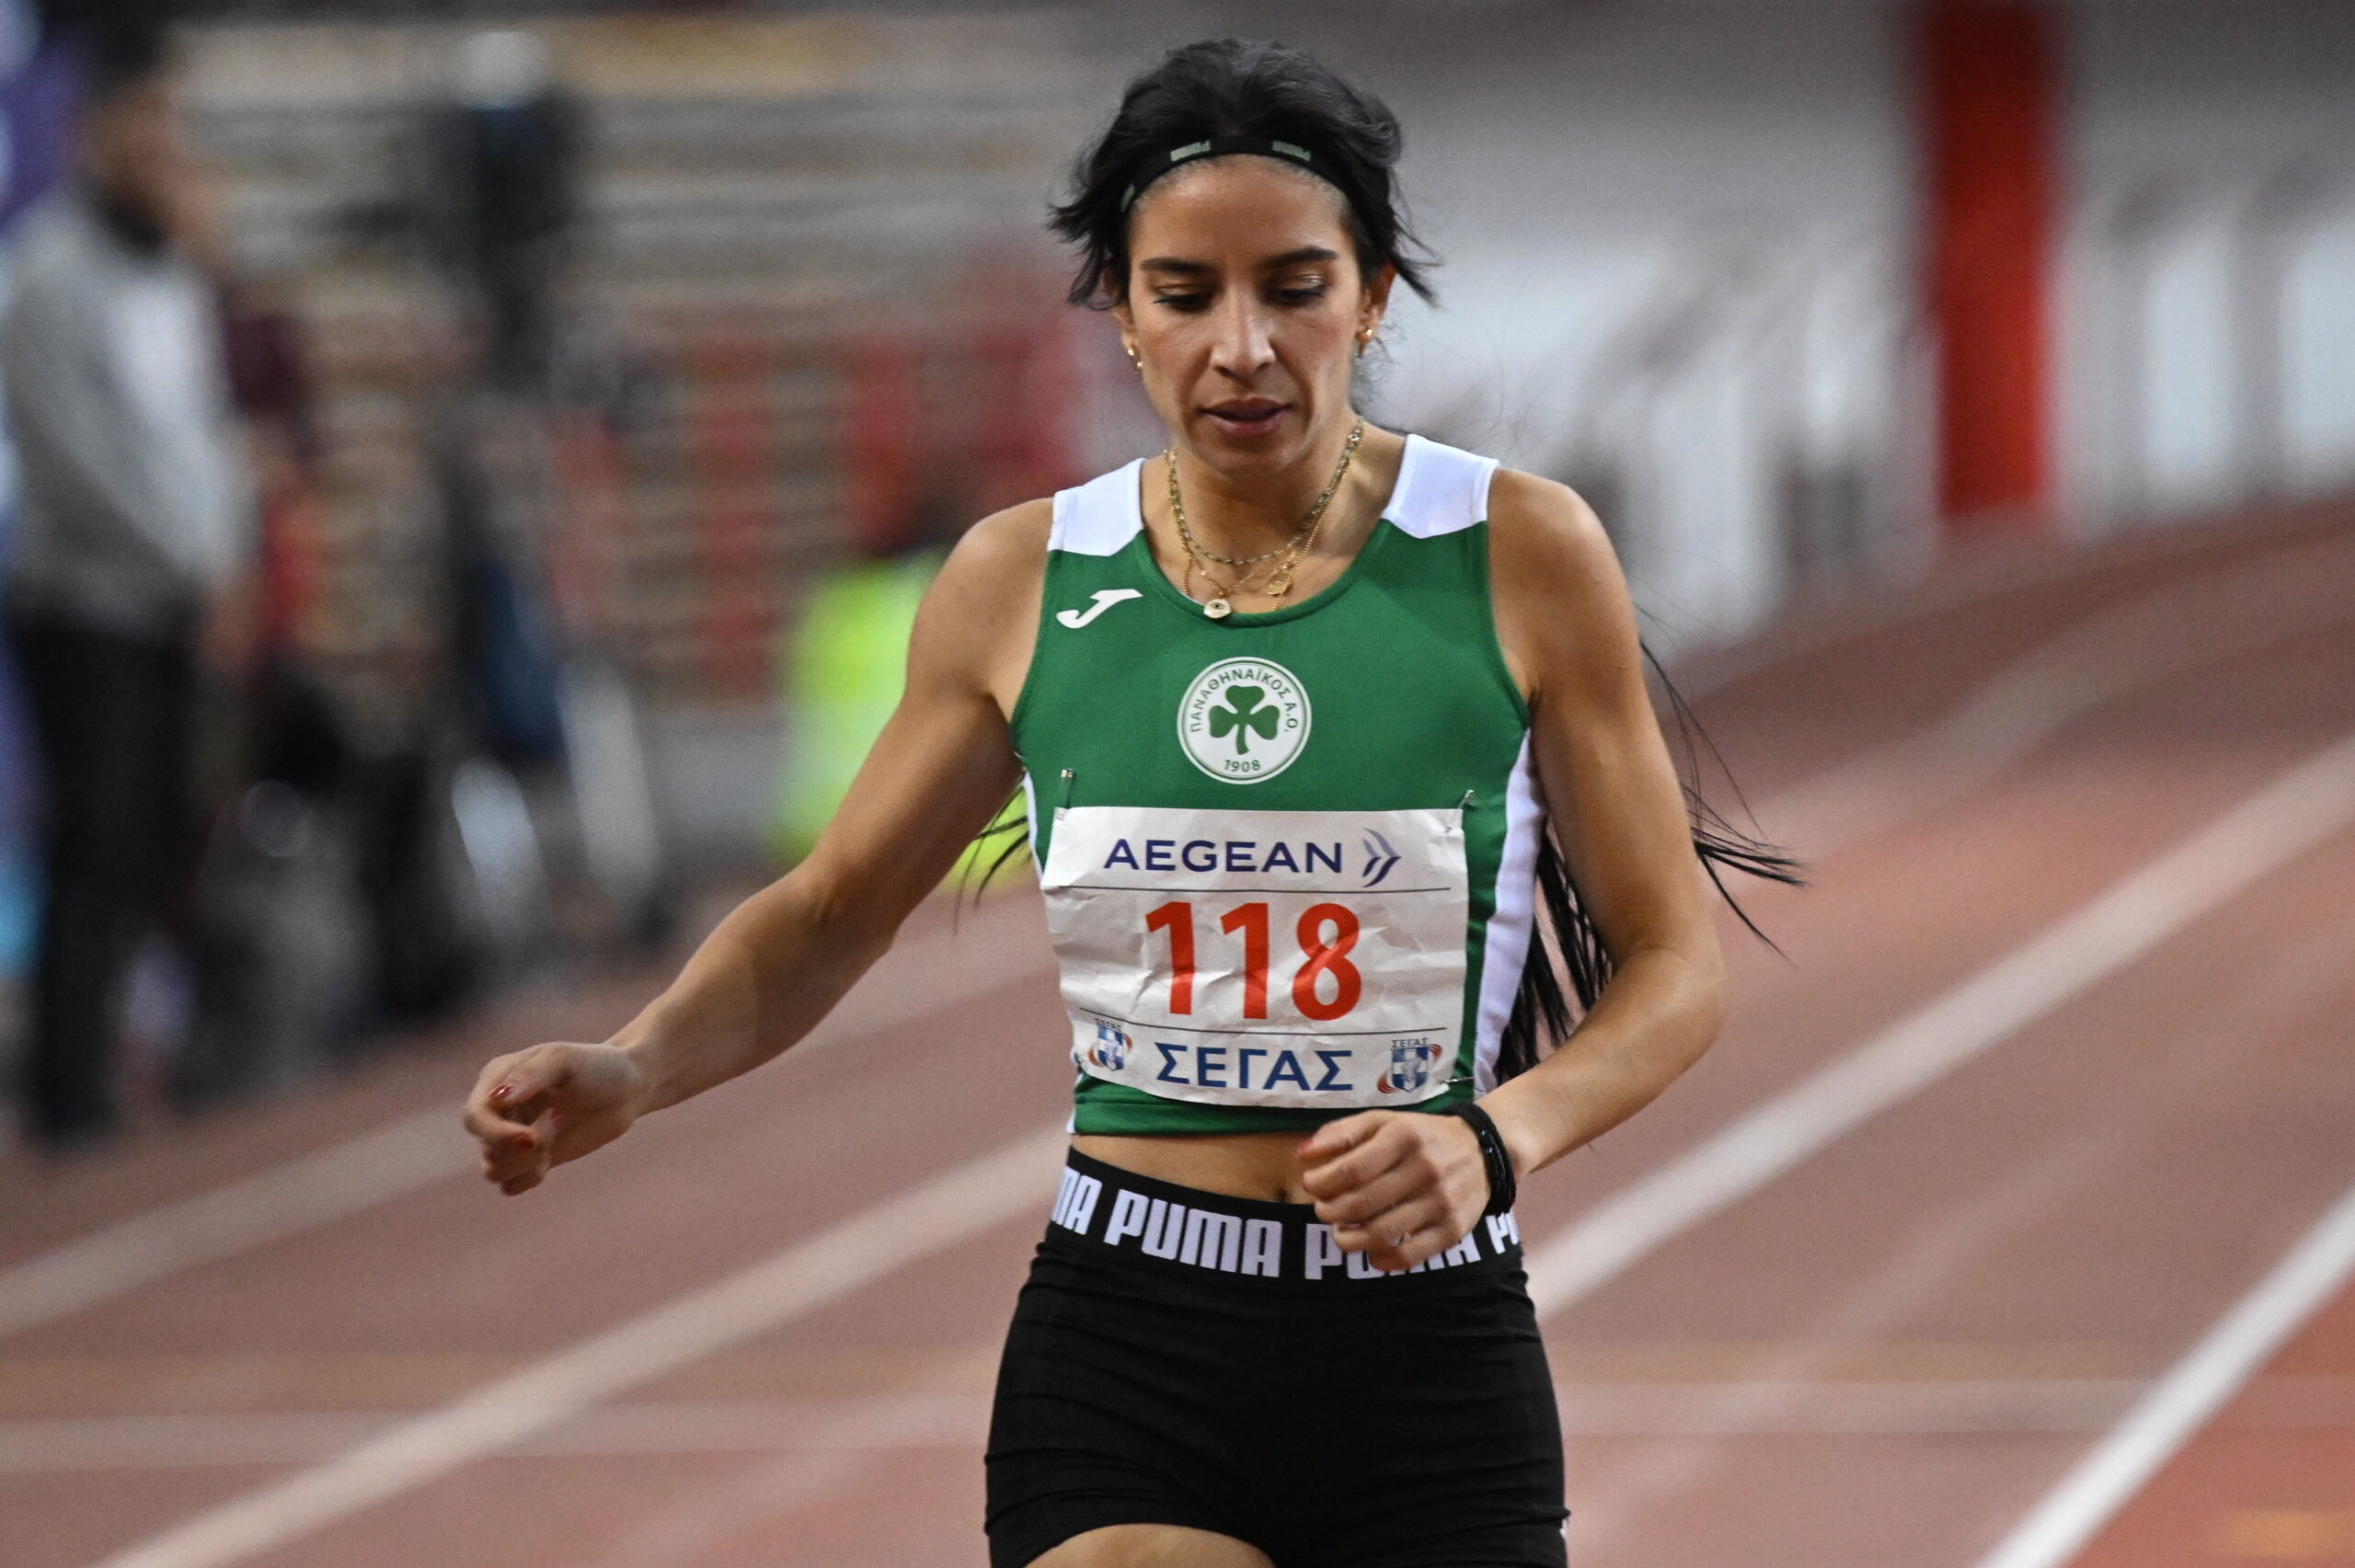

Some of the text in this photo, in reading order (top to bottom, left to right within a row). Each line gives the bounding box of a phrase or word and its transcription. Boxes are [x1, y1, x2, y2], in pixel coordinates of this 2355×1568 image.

[1223, 759, 1260, 773] 1908
[1104, 838, 1342, 874] AEGEAN
[1145, 901, 1362, 1022] 118
[1391, 1037, 1430, 1048] ΣΕΓΑΣ
[1155, 1041, 1353, 1092] ΣΕΓΑΣ
[1104, 1188, 1283, 1278] PUMA
